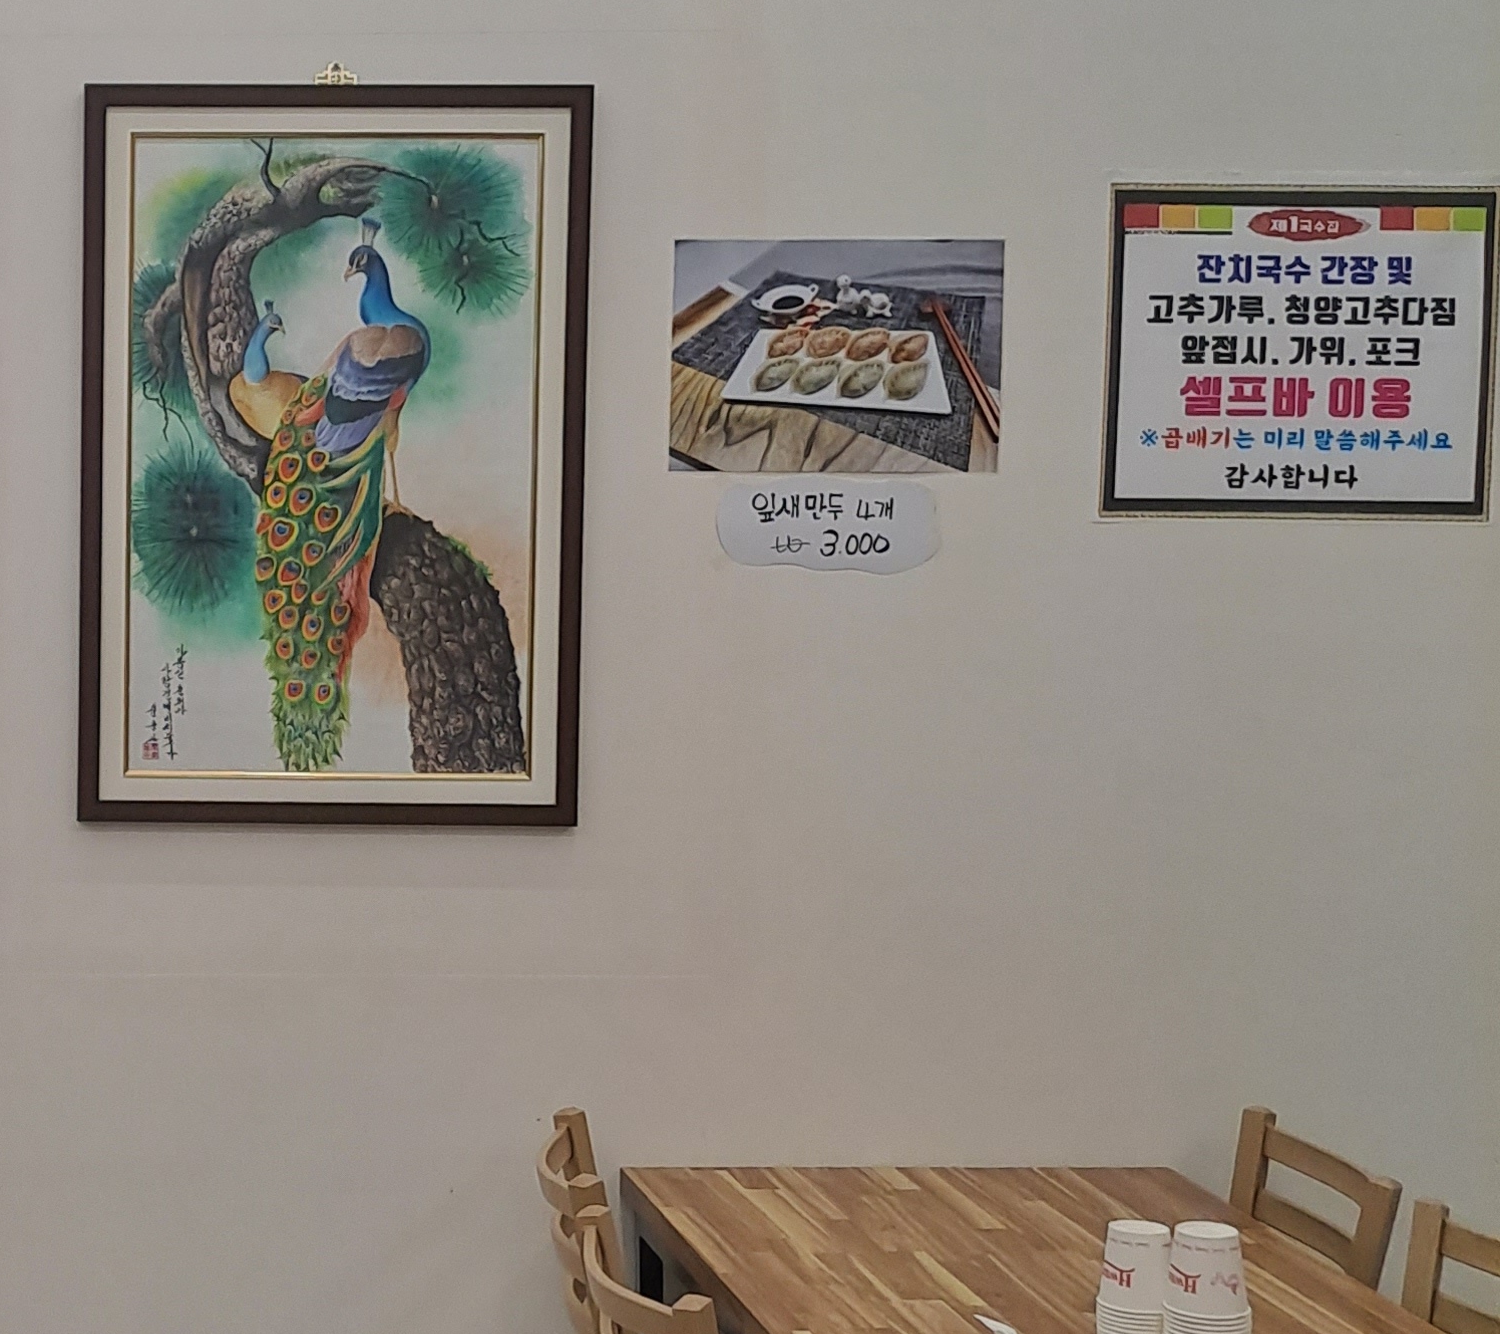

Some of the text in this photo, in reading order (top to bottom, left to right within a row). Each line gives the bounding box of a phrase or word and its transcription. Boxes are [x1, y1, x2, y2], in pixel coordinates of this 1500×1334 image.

[1196, 254, 1413, 285] 잔치국수 간장 및
[1284, 294, 1457, 327] 청양고추다짐
[1364, 337, 1422, 367] 포크
[1179, 375, 1412, 419] 셀프바 이용
[1263, 426, 1306, 450] 미리
[1313, 428, 1454, 452] 말씀해주세요
[1224, 463, 1360, 490] 감사합니다
